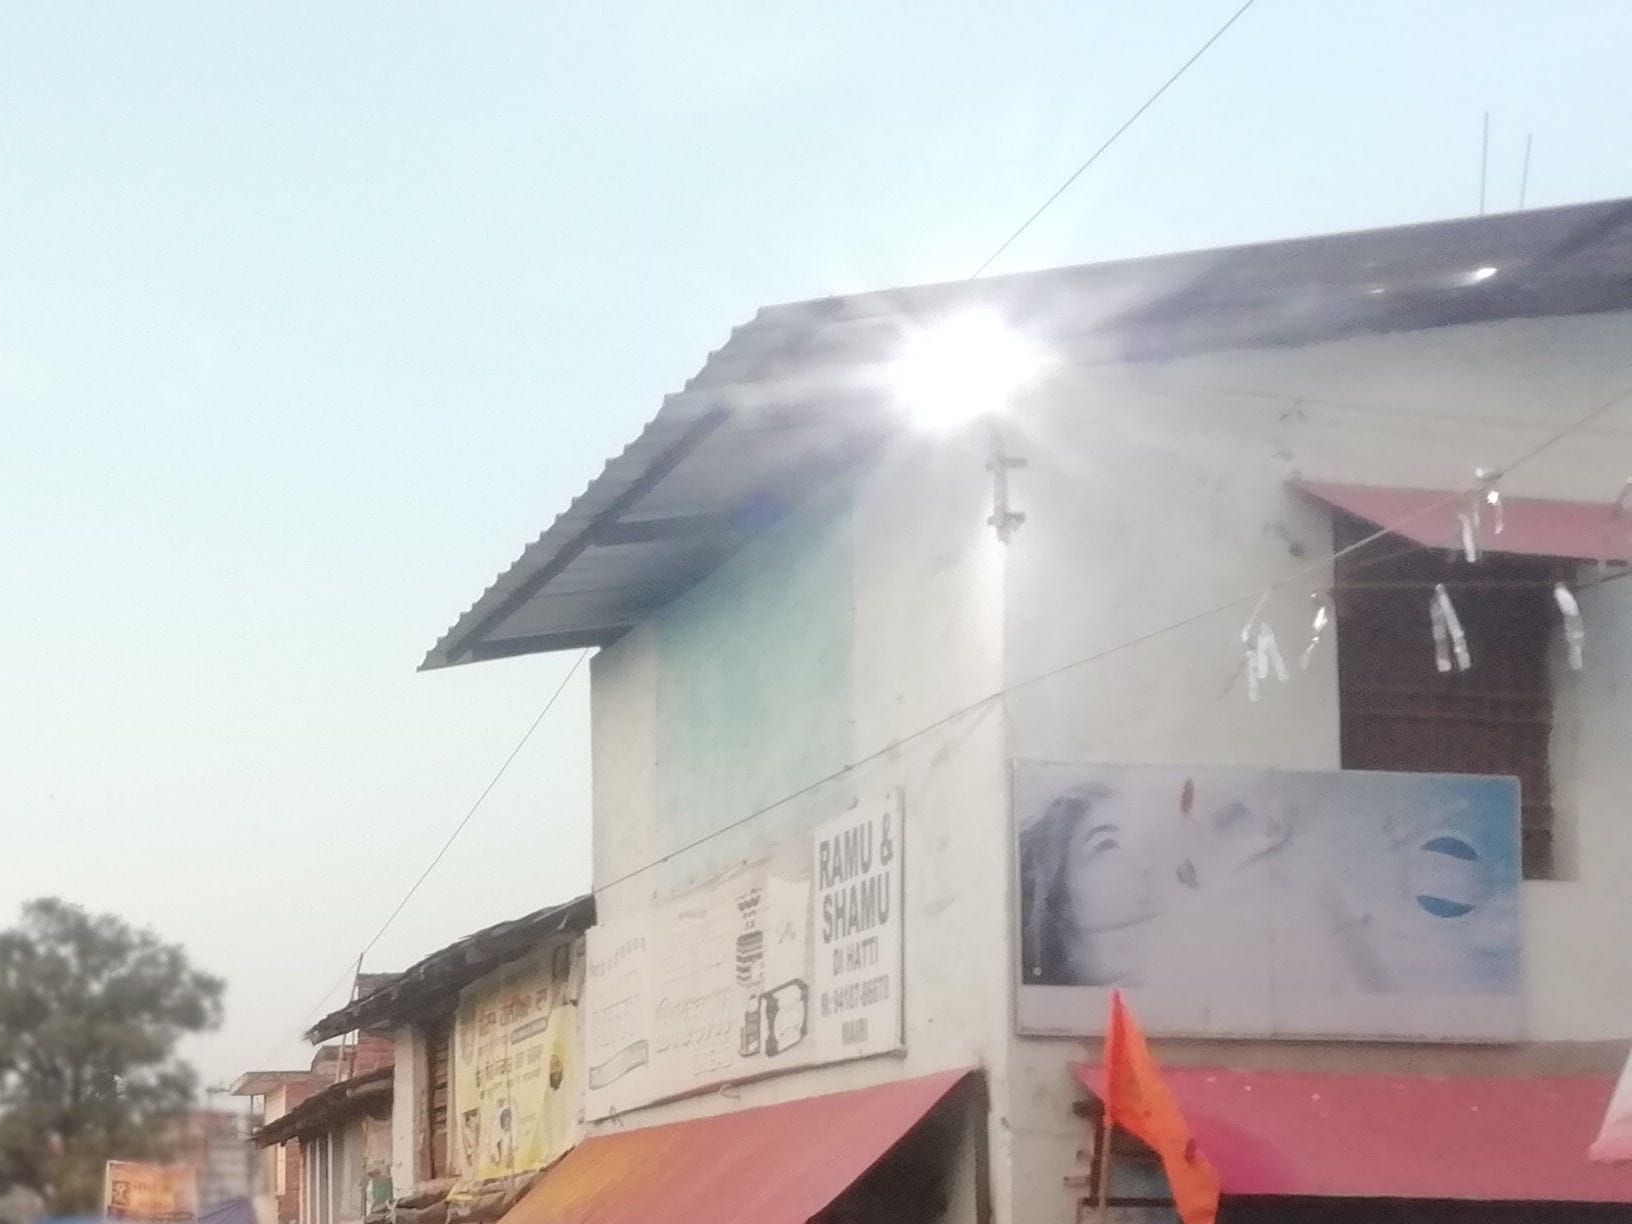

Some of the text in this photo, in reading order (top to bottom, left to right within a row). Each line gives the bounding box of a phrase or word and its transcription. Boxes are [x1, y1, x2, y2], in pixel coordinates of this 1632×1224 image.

[819, 811, 894, 891] RAMU &
[822, 869, 890, 944] SHAMU
